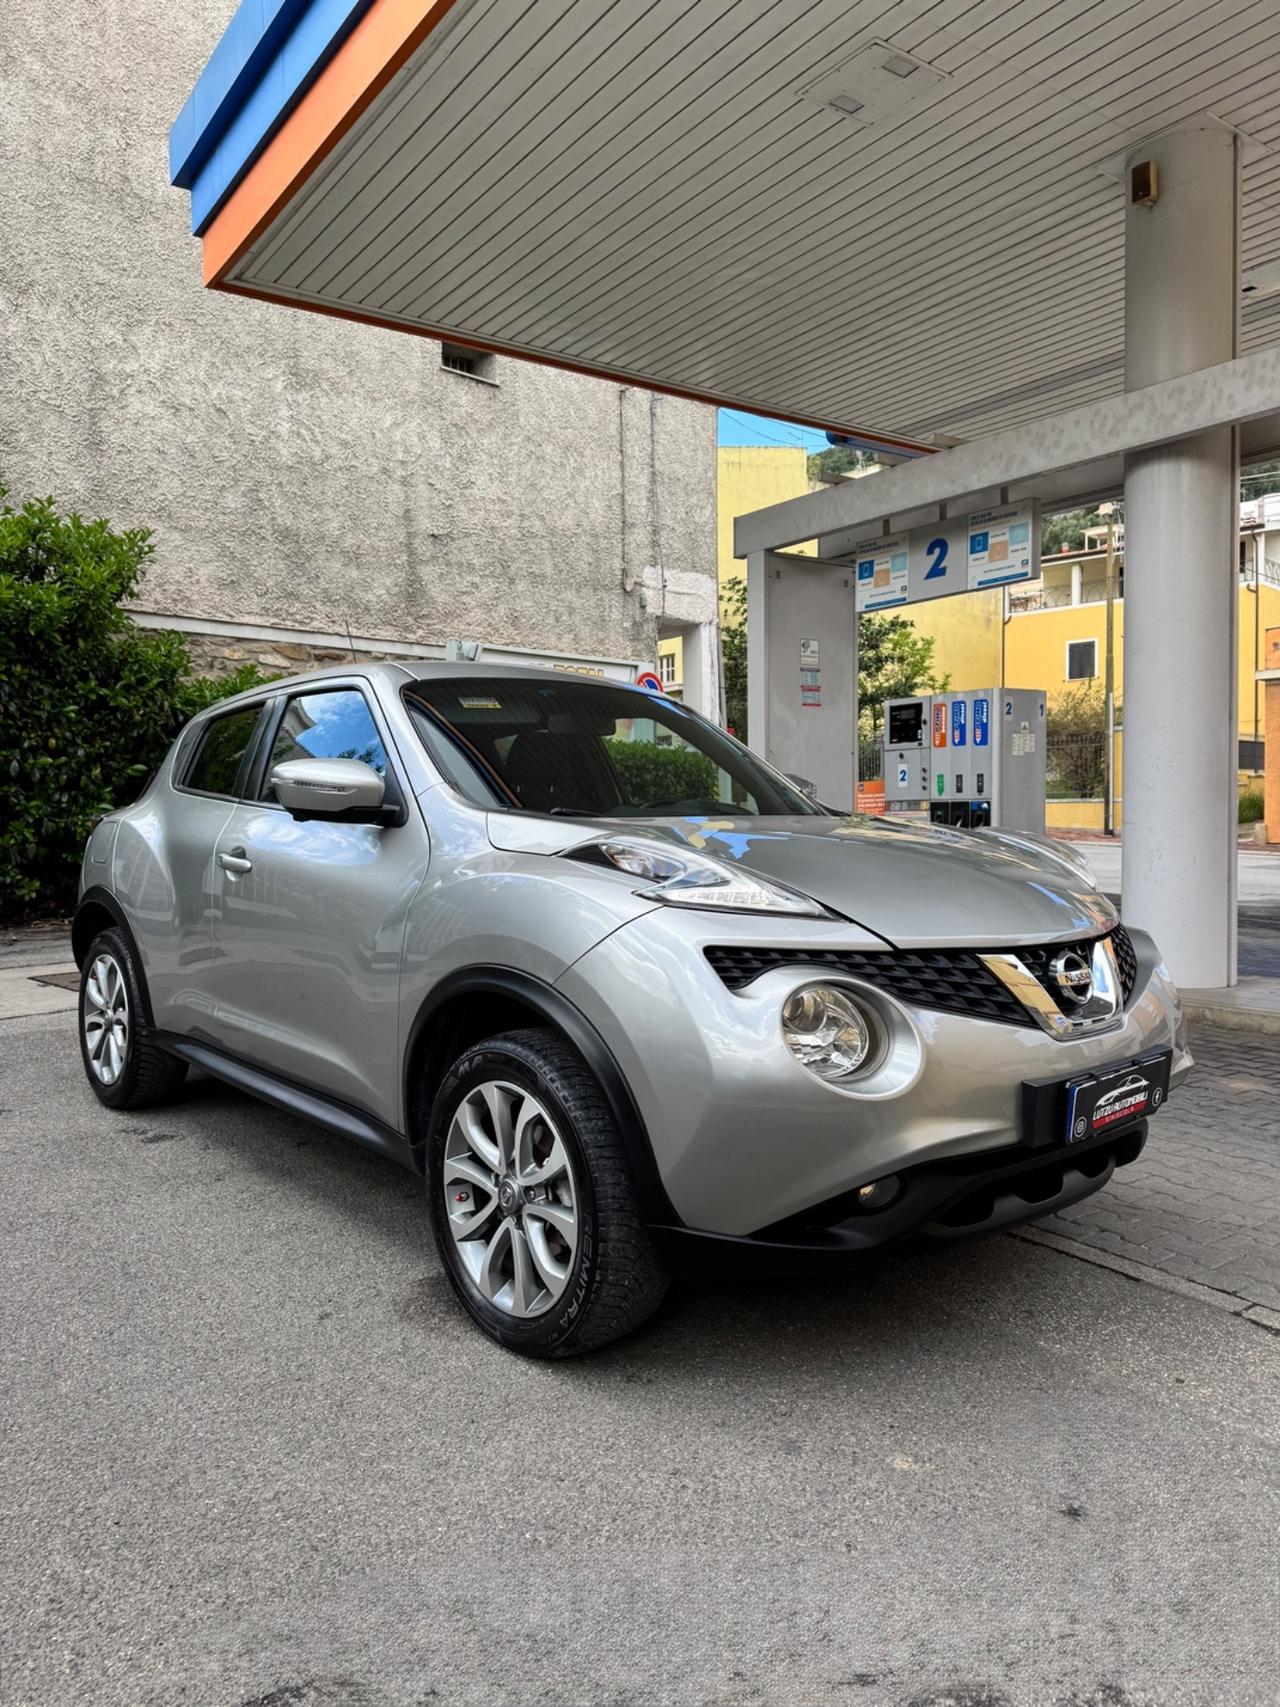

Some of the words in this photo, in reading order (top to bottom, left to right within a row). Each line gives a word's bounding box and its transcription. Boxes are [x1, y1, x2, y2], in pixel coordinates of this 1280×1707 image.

[924, 538, 949, 580] 2
[1005, 702, 1012, 715] 2
[1039, 704, 1044, 716] 1
[900, 770, 907, 781] 2
